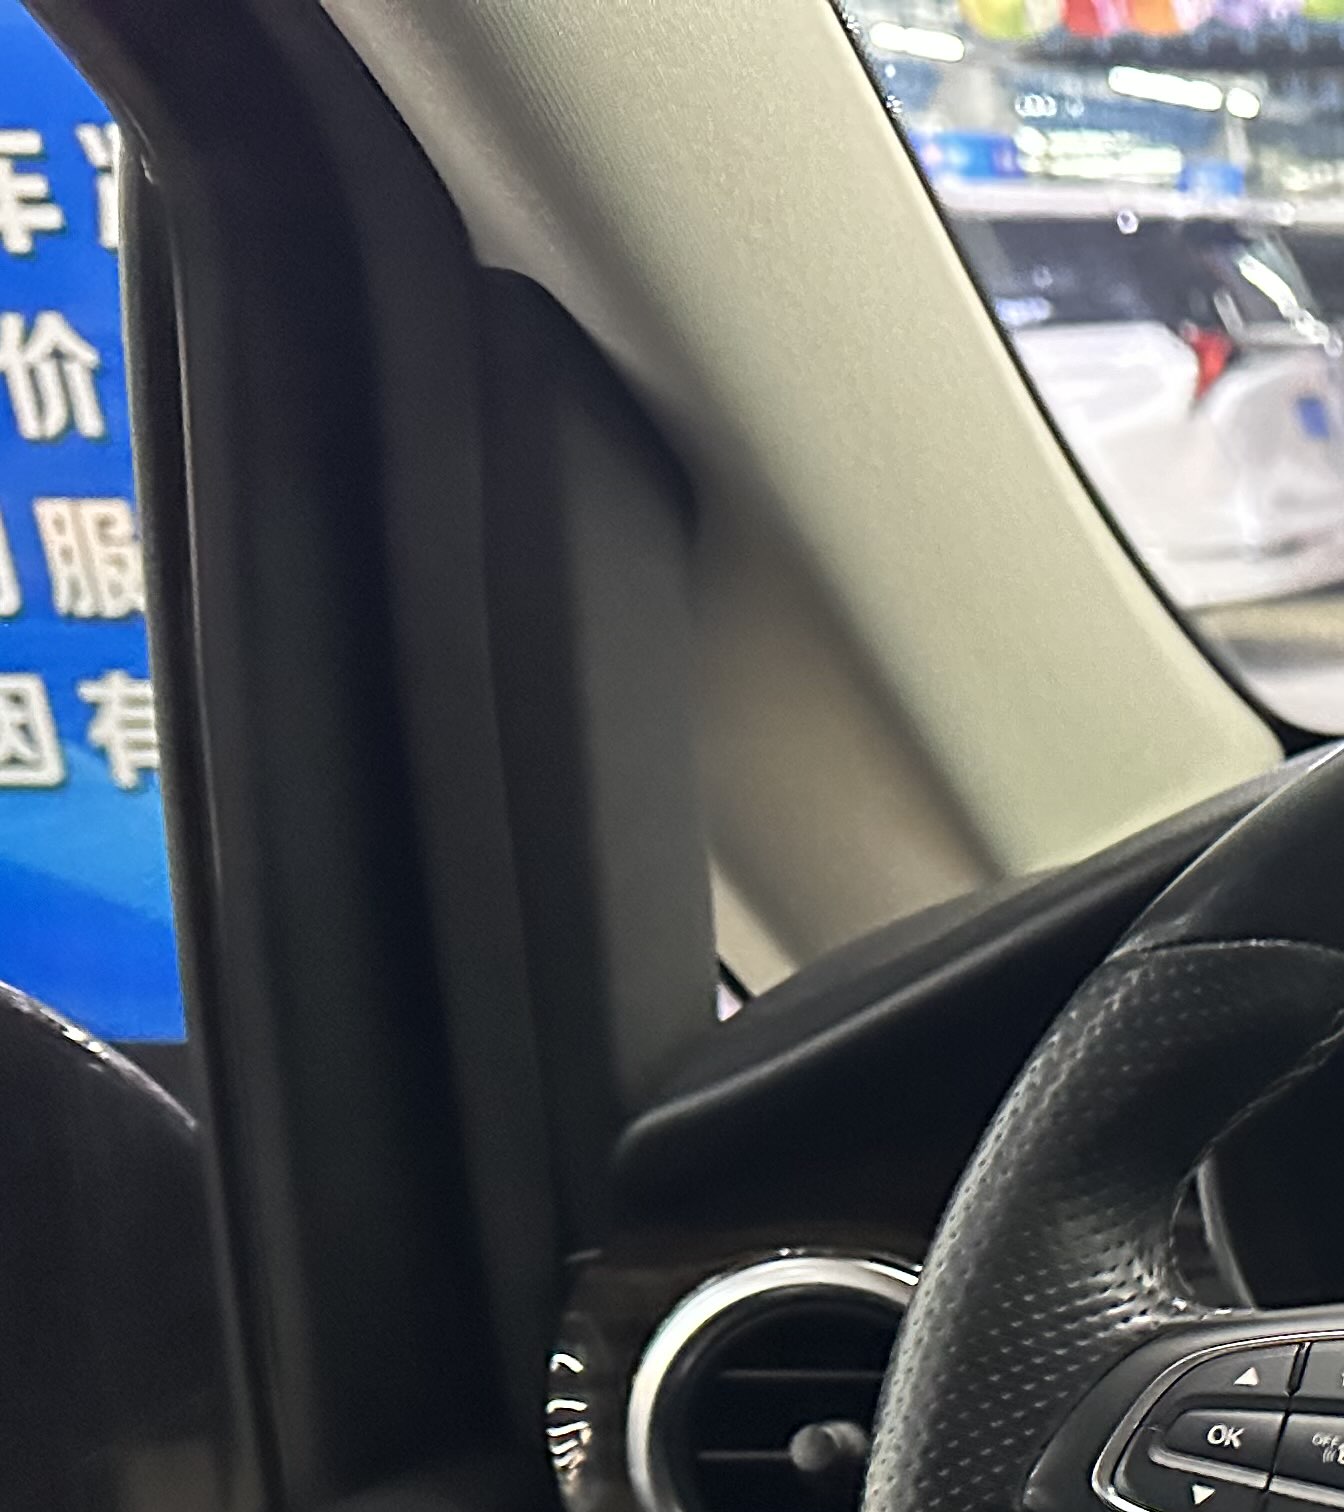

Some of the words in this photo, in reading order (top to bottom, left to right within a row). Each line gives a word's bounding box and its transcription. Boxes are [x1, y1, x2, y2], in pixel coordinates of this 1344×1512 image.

[0, 119, 121, 255] 车
[0, 311, 106, 442] 价
[0, 497, 148, 621] 服
[1206, 1424, 1245, 1449] OK
[1312, 1433, 1343, 1449] OFF
